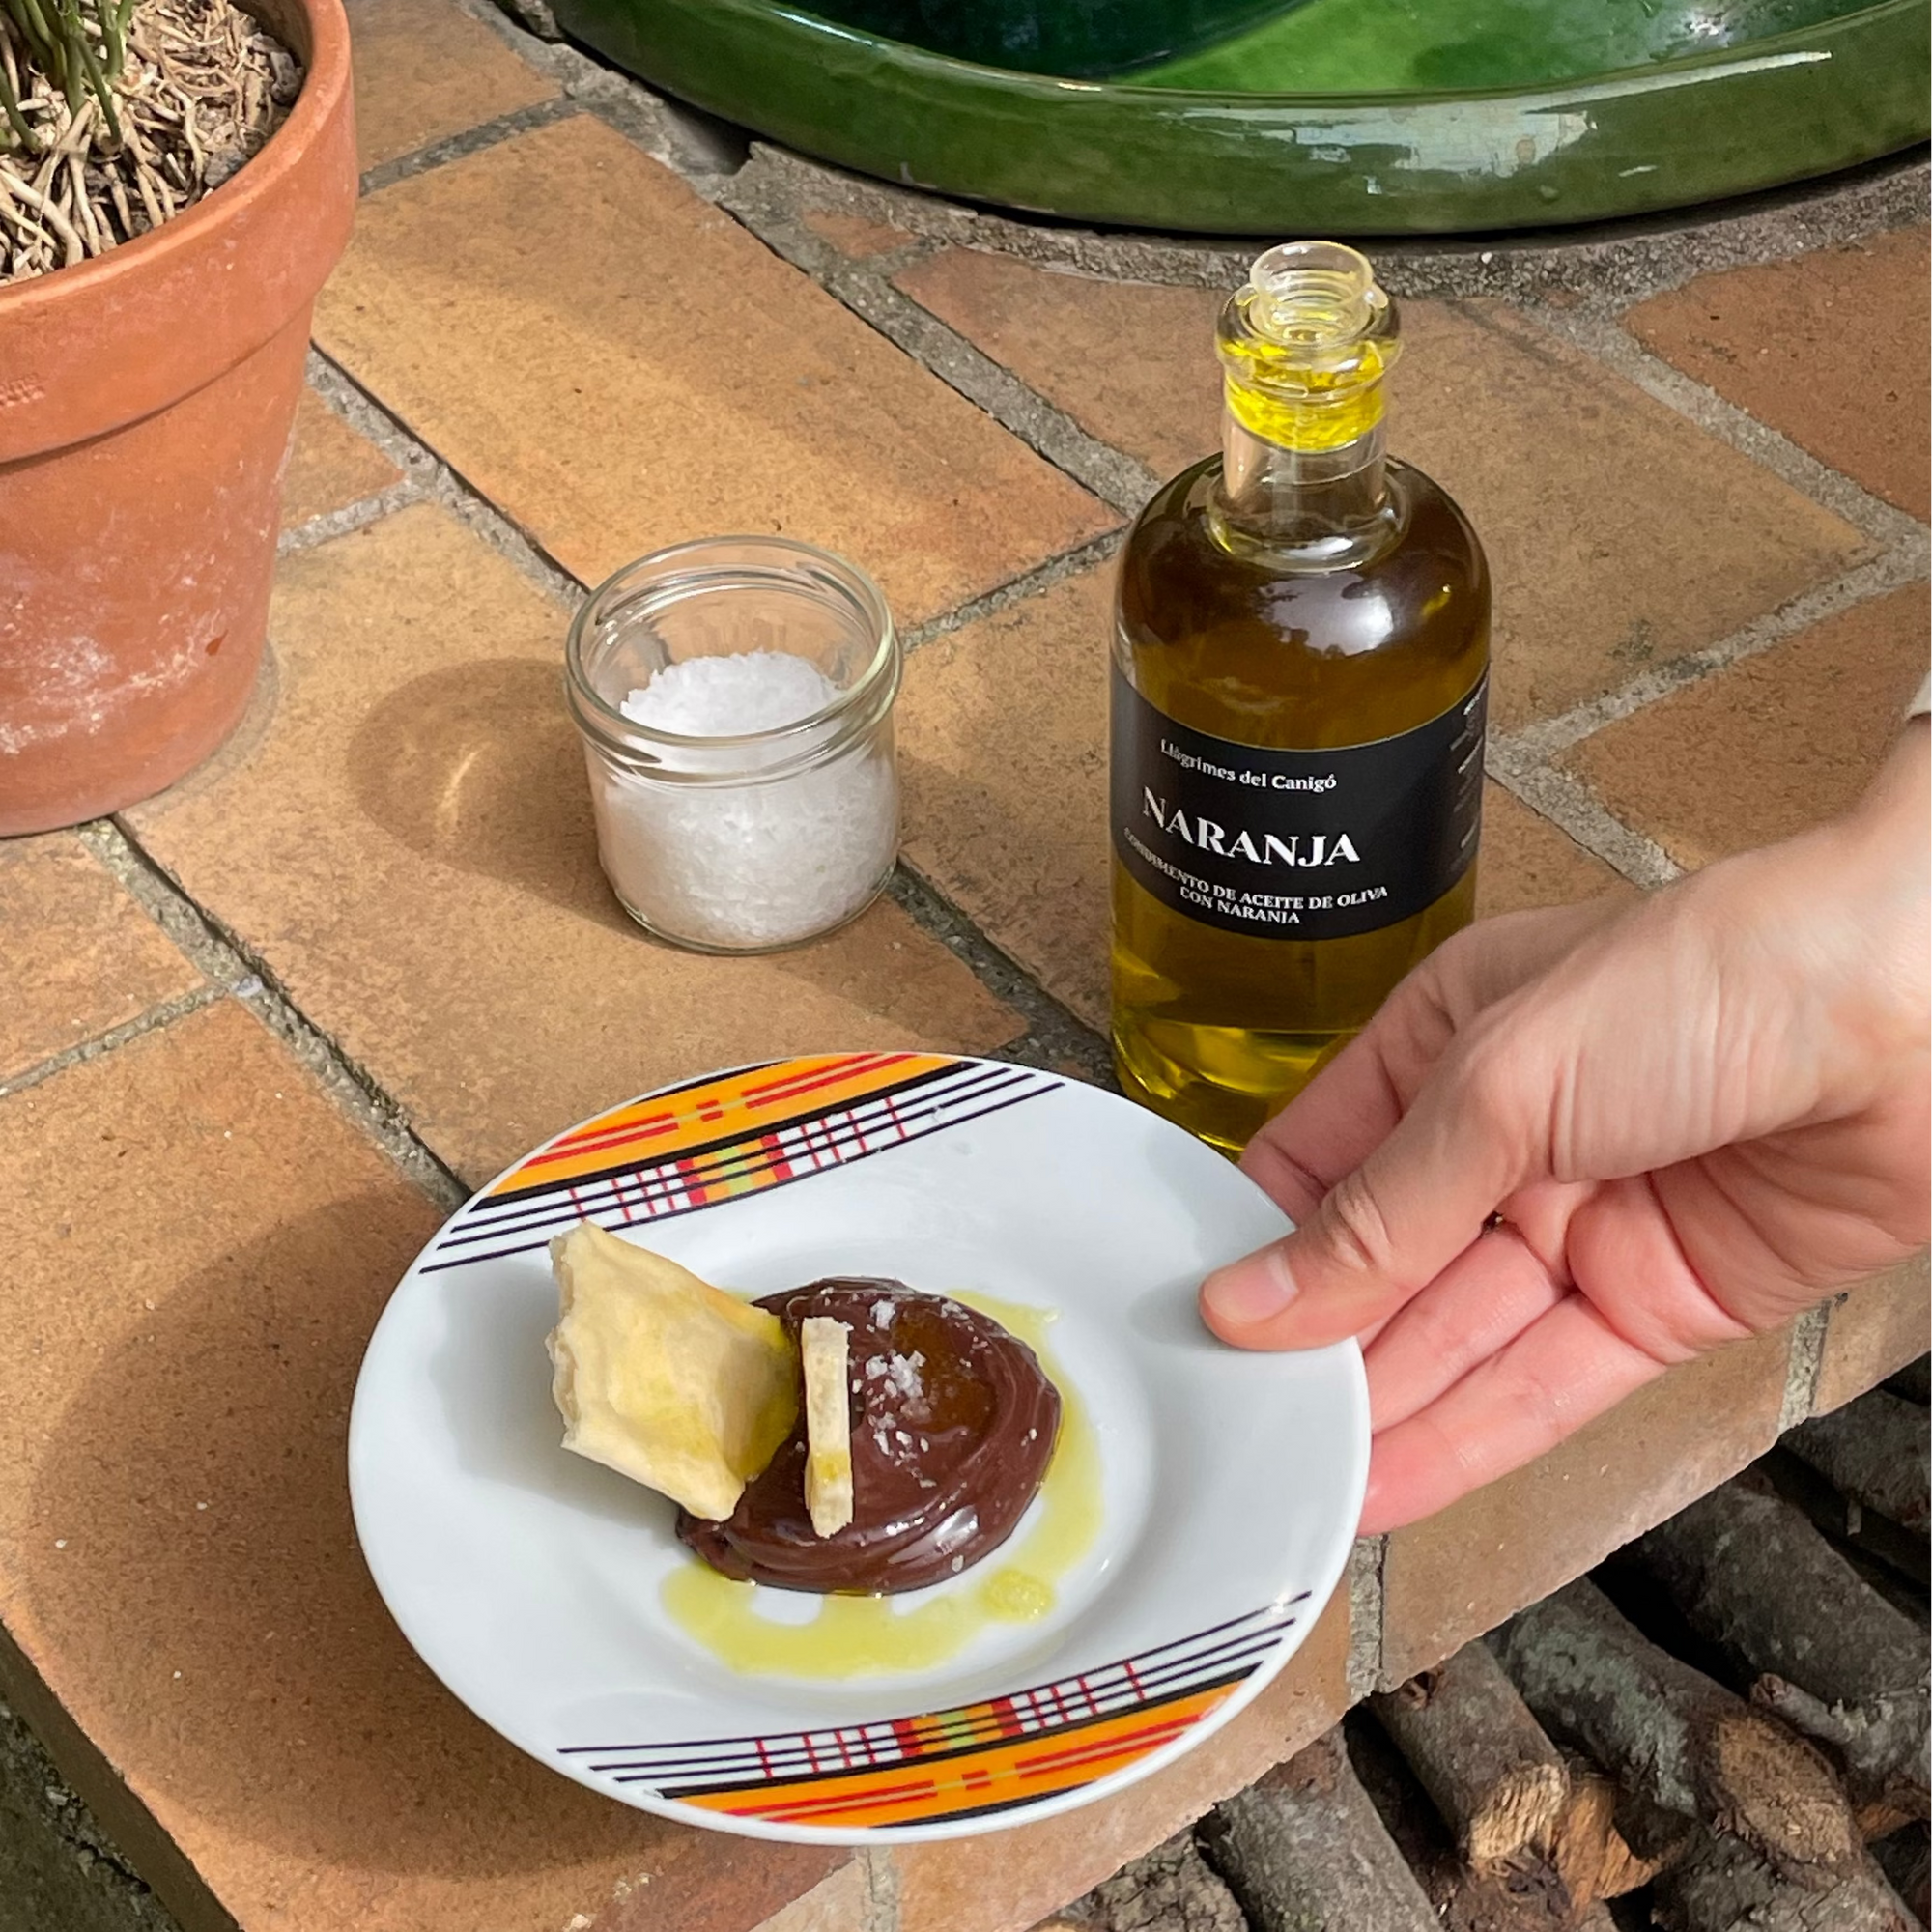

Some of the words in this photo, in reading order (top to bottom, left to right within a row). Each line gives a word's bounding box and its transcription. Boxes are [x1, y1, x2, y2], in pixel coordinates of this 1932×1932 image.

[1239, 770, 1266, 787] del
[1271, 774, 1337, 793] Canigó
[1142, 785, 1360, 867] NARANJA
[1179, 886, 1213, 909] CON
[1217, 899, 1300, 924] NARANJA
[1213, 884, 1236, 901] DE
[1239, 892, 1304, 910] ACEITE
[1308, 895, 1333, 910] DE
[1336, 886, 1388, 907] OLIVA
